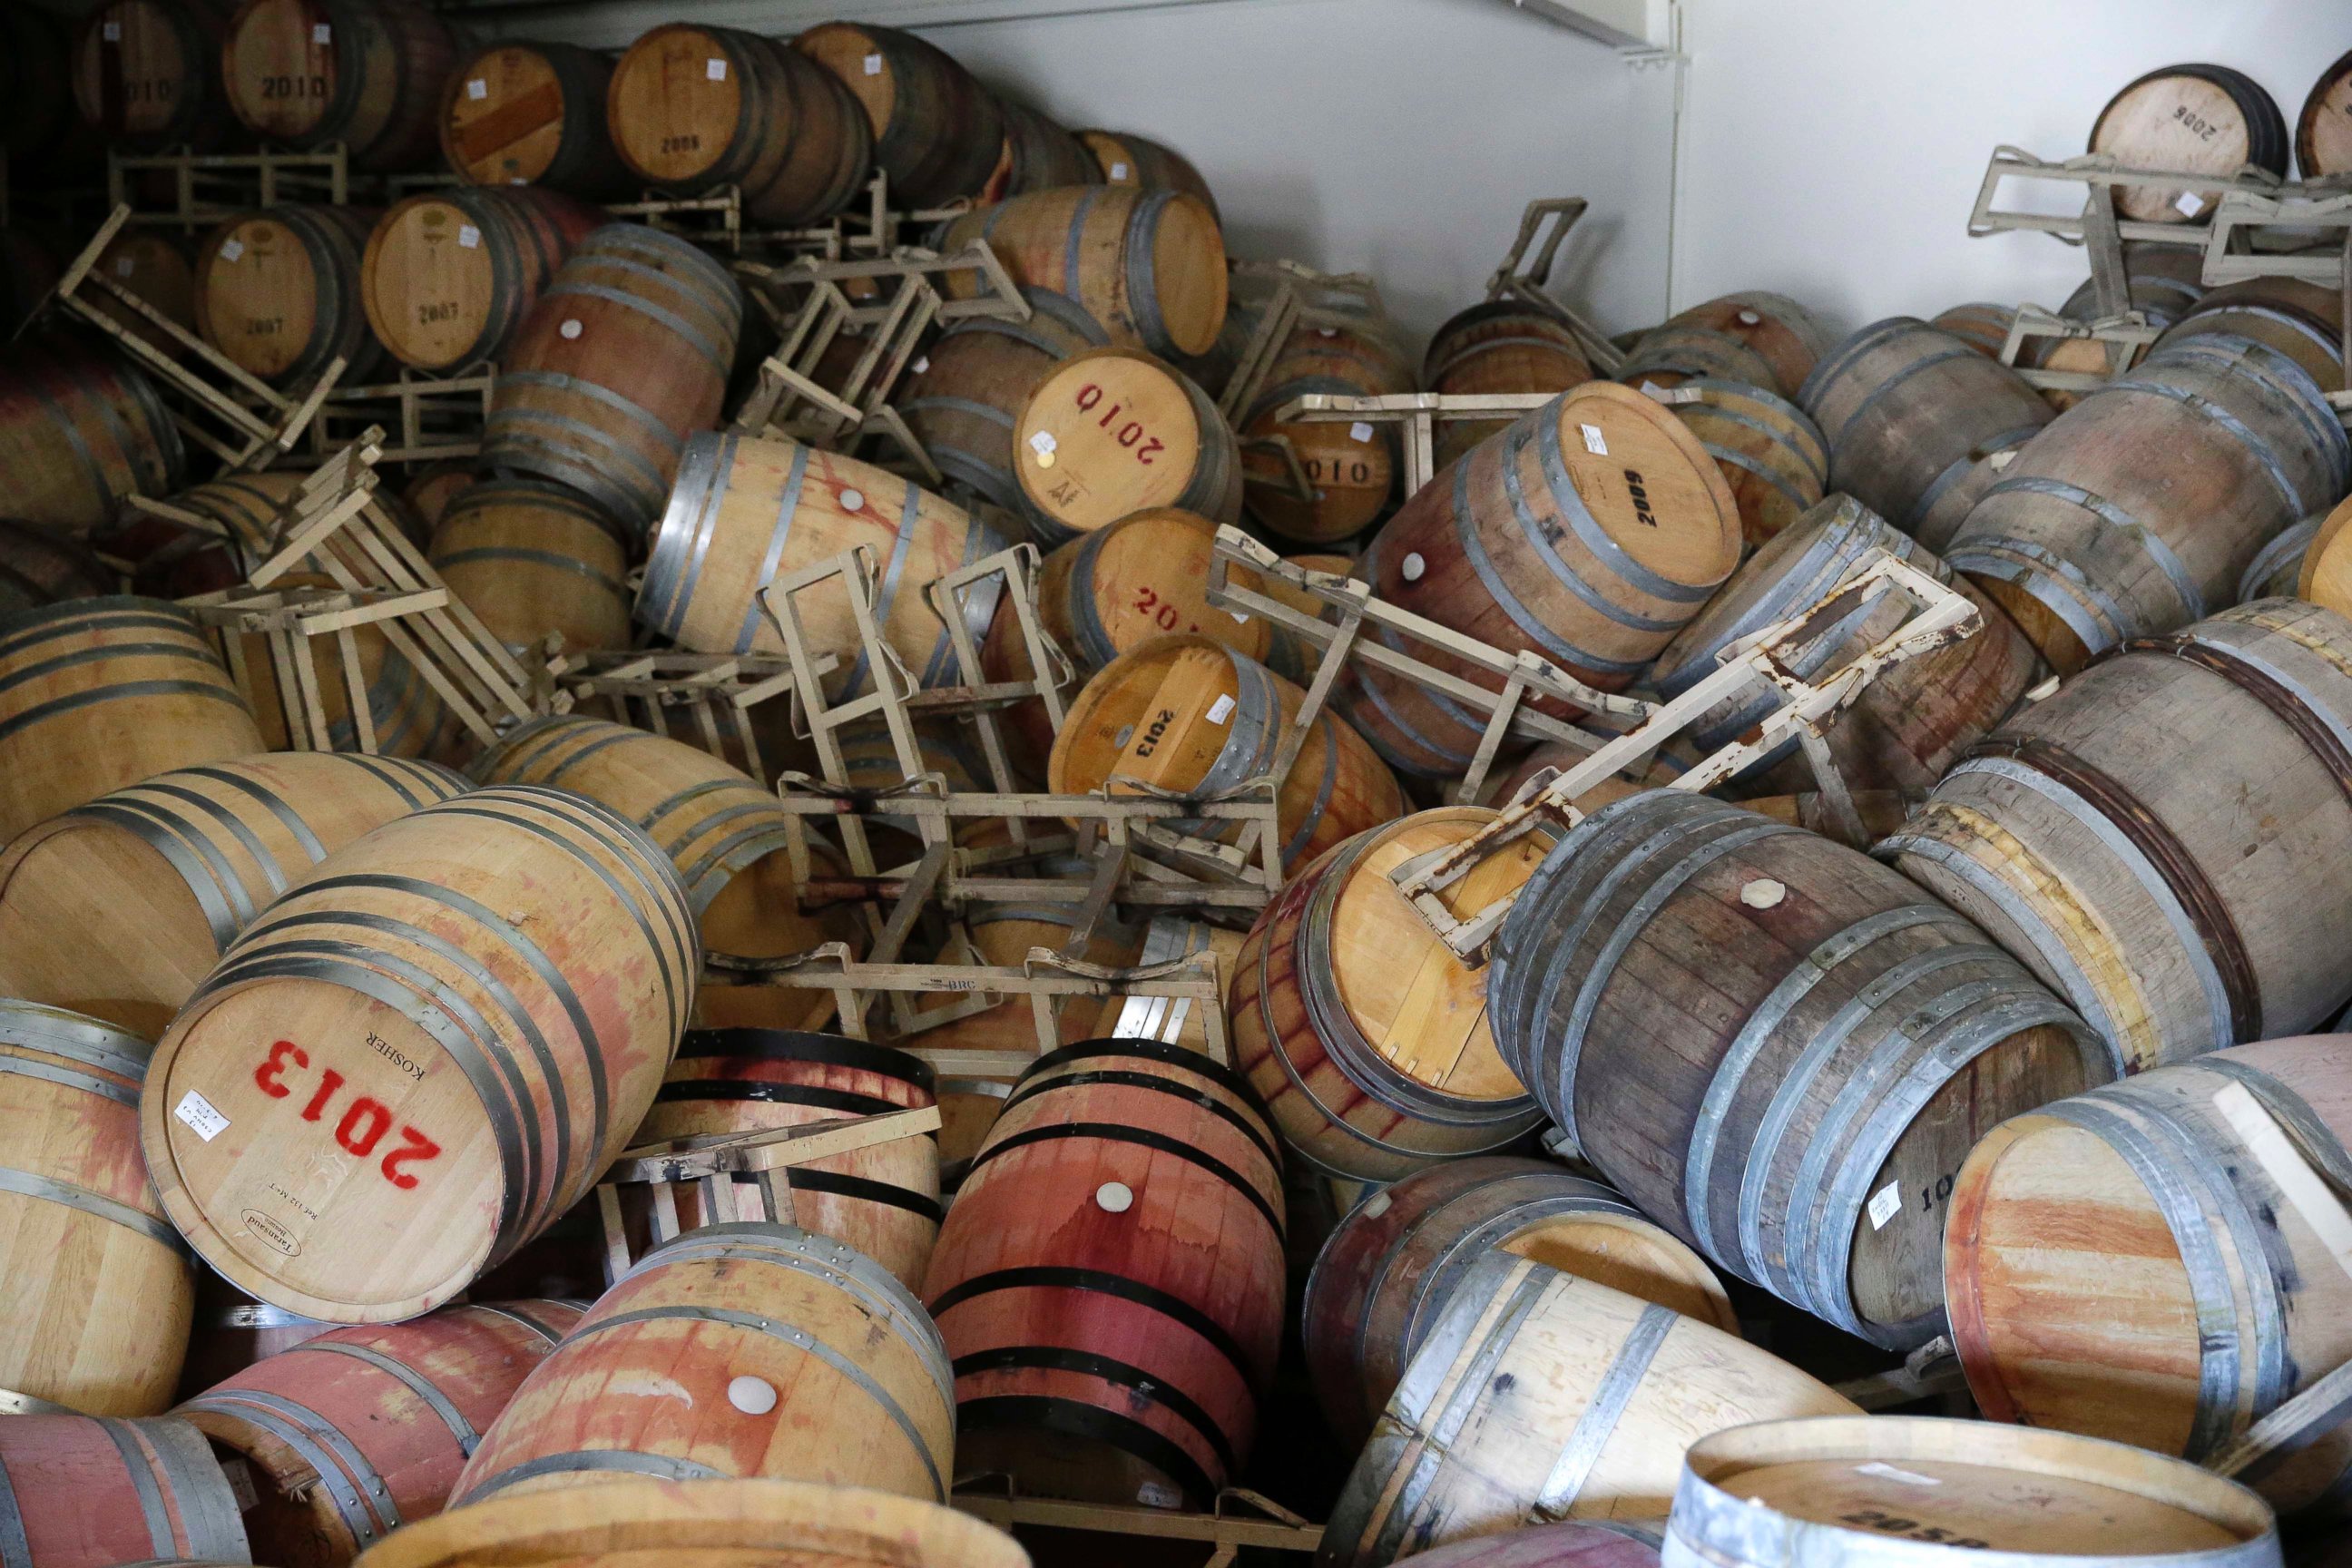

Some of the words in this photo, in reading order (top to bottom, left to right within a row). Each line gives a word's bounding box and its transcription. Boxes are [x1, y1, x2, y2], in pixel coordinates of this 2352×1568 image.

[262, 76, 328, 98] 2010
[1076, 384, 1165, 465] 2010
[1306, 458, 1368, 484] 010
[1624, 469, 1658, 528] 2009
[1132, 586, 1200, 632] 20
[1136, 710, 1177, 758] 2013
[948, 980, 976, 990] BRC
[366, 1031, 426, 1081] KOSHER
[254, 1040, 442, 1190] 2013
[289, 1197, 303, 1209] 132
[1922, 1161, 1964, 1212] 10
[247, 1215, 292, 1253] Taransaud
